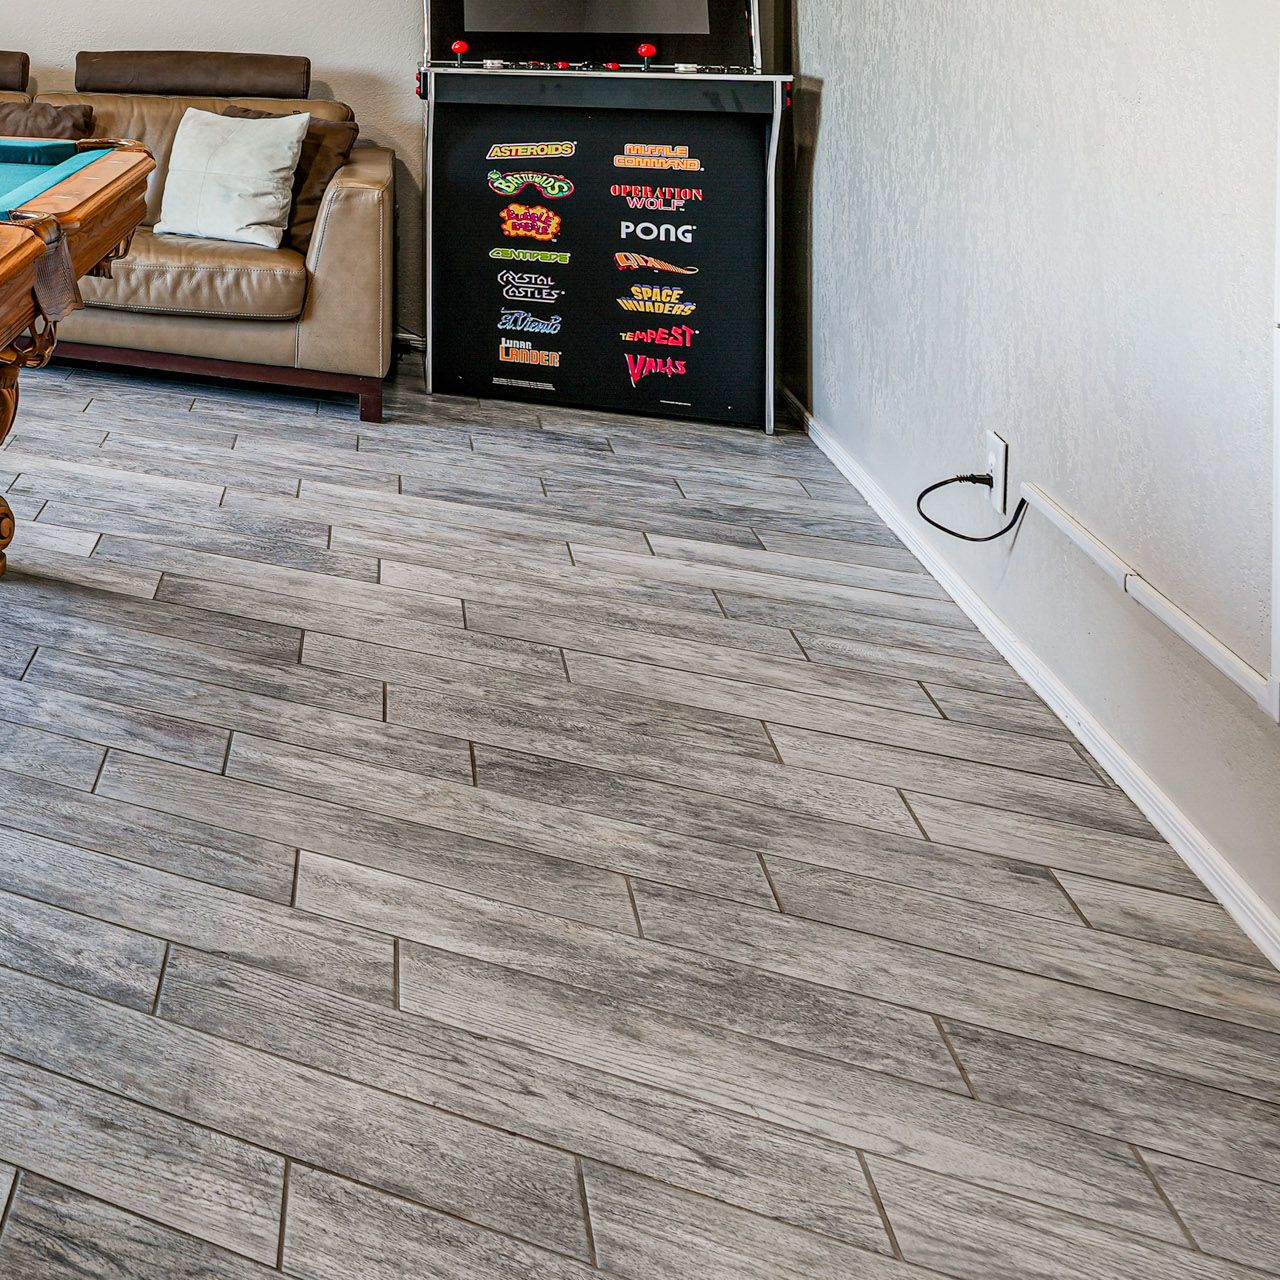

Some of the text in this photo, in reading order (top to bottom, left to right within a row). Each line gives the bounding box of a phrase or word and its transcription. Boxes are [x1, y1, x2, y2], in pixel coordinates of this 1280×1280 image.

[490, 143, 572, 157] ASTEROIDS
[625, 144, 688, 157] MISSILE
[614, 155, 700, 171] COMMAND
[610, 185, 704, 201] OPERATION
[626, 197, 685, 211] WOLF
[621, 221, 692, 243] PONG
[489, 248, 571, 263] CENTIPEDE
[497, 270, 556, 288] CRYSTAL
[503, 284, 560, 303] CASTLES
[631, 284, 683, 303] SPACE
[616, 298, 696, 315] INVADERS
[620, 325, 694, 347] TEMPEST
